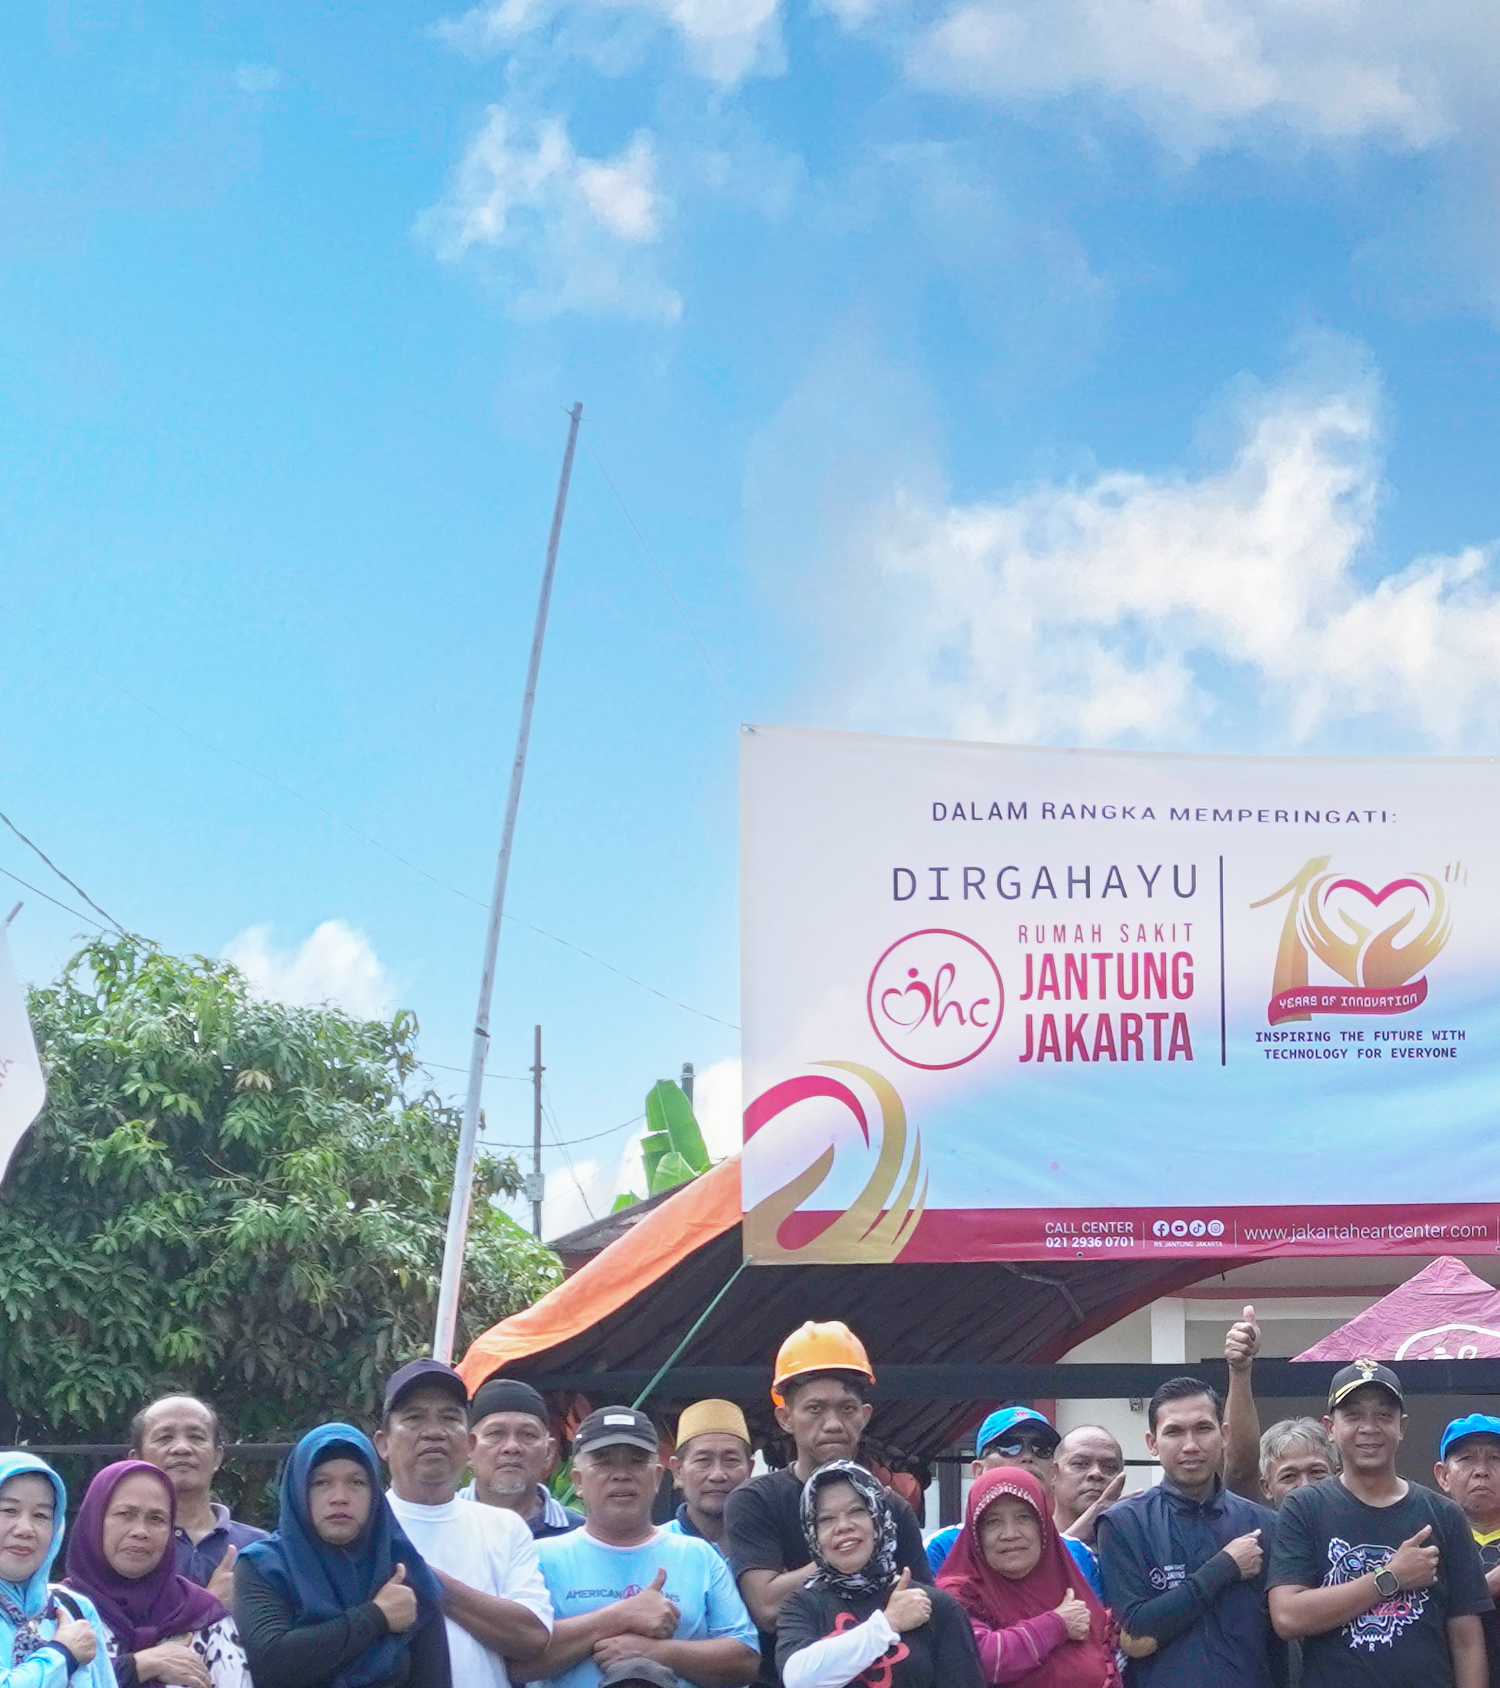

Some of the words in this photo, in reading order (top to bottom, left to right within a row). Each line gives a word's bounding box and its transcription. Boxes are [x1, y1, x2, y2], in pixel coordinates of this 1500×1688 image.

[932, 801, 1028, 821] DALAM
[1042, 802, 1156, 821] RANGKA
[1169, 806, 1397, 824] MEMPERINGATI:
[892, 864, 1197, 902] DIRGAHAYU
[1018, 923, 1102, 944] RUMAH
[1120, 922, 1193, 943] SAKIT
[1019, 951, 1194, 1000] JANTUNG
[1018, 1012, 1194, 1063] JAKARTA
[1255, 1031, 1331, 1043] INSPIRING
[1340, 1031, 1365, 1042] THE
[1373, 1030, 1424, 1042] FUTURE
[1432, 1030, 1466, 1042] WITH
[1264, 1048, 1348, 1060] TECHNOLOGY
[1357, 1048, 1382, 1059] FOR
[1390, 1047, 1458, 1059] EVERYONE
[1045, 1221, 1078, 1234] CALL
[1084, 1221, 1134, 1234] CENTER
[1244, 1222, 1488, 1242] www.jakartaheartcenter.com
[1045, 1236, 1068, 1248] 021
[1071, 1236, 1102, 1248] 2936
[1105, 1236, 1134, 1248] 0701
